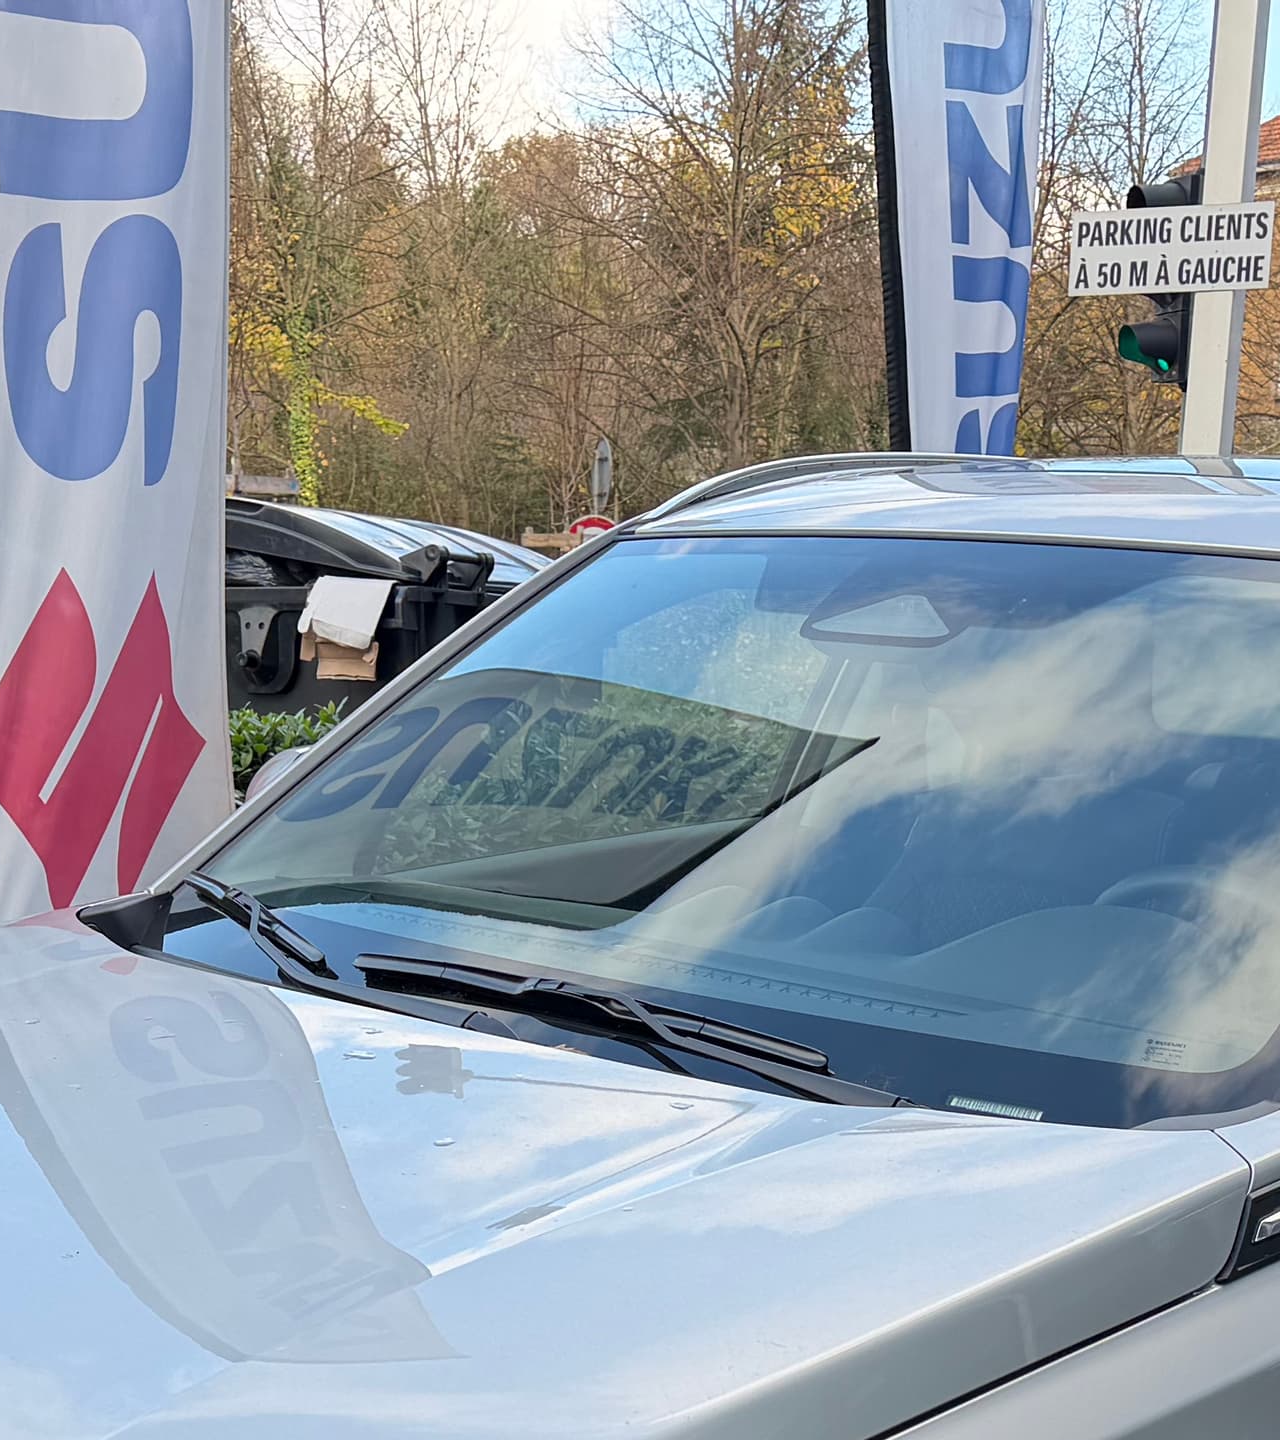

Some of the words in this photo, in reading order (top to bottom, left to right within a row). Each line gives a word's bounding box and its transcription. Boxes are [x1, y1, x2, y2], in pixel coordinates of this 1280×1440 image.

[1076, 217, 1172, 247] PARKING
[1180, 211, 1269, 243] CLIENTS
[1074, 257, 1089, 289] À
[1097, 262, 1122, 288] 50
[1129, 260, 1148, 287] M
[1154, 254, 1170, 286] À
[1177, 255, 1266, 285] GAUCHE
